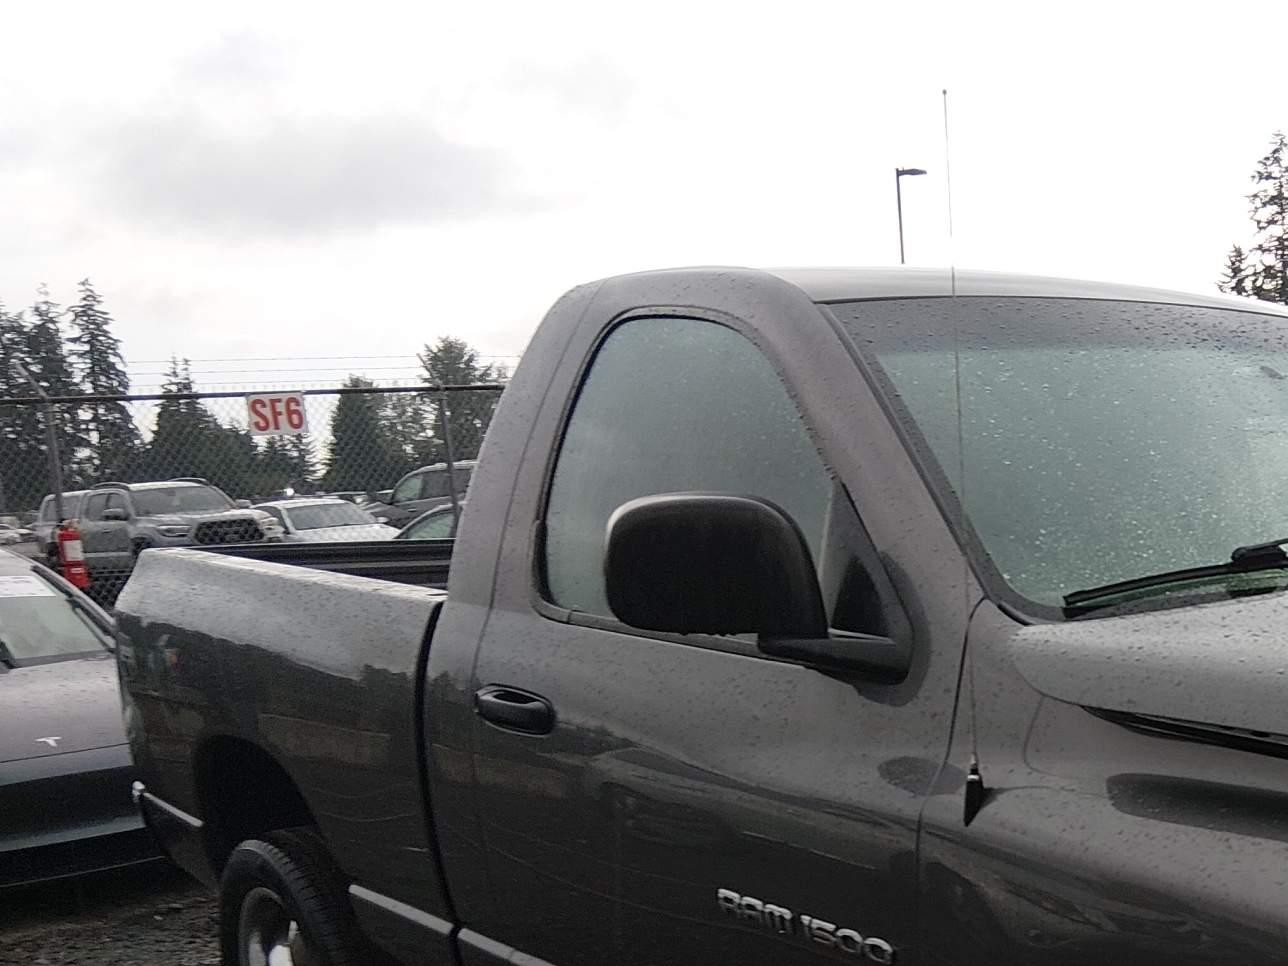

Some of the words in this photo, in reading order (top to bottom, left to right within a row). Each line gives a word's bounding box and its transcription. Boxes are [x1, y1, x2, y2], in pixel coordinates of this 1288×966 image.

[250, 397, 304, 432] SF6
[717, 888, 793, 935] RAM
[800, 914, 893, 966] 1500
